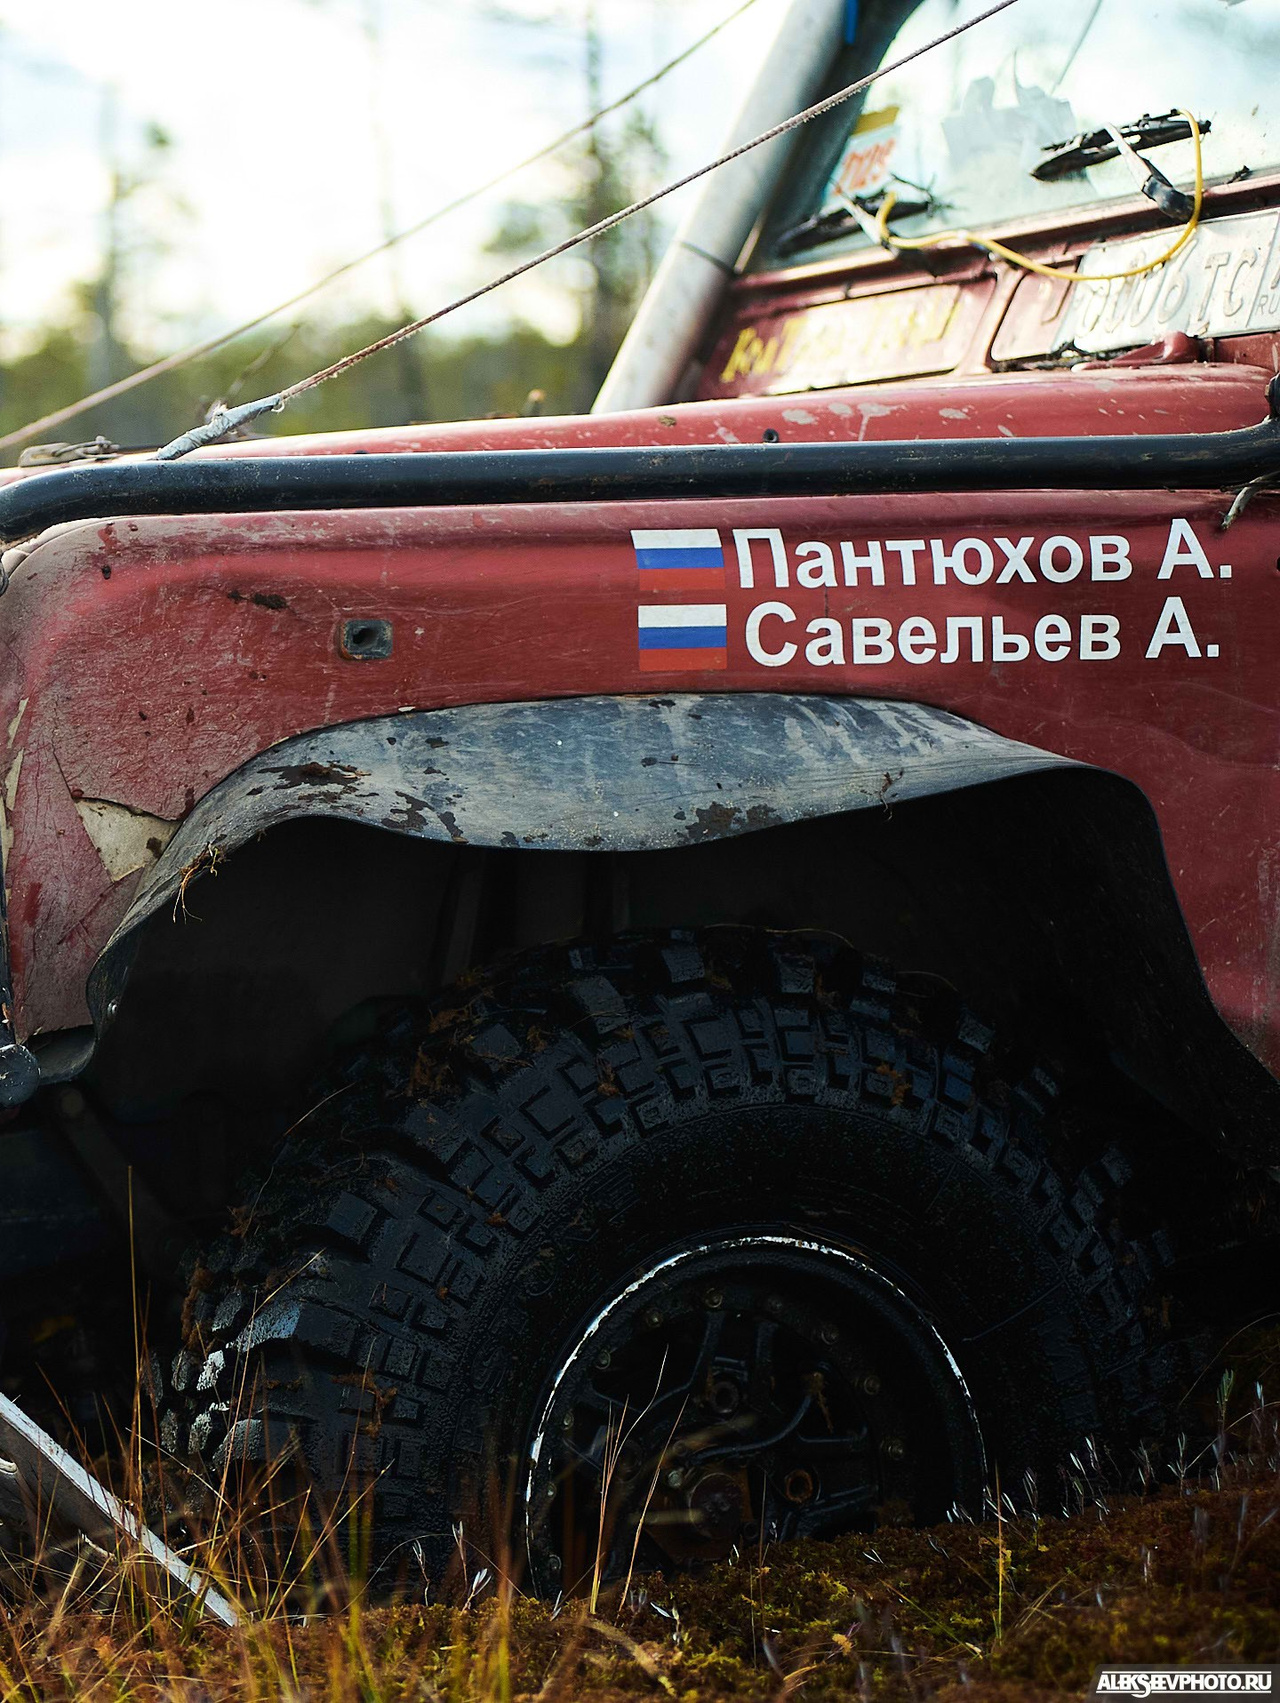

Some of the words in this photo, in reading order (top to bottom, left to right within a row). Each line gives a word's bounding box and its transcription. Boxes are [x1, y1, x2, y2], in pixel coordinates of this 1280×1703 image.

[732, 528, 1133, 589] Пантюхов
[1156, 518, 1233, 580] А.
[745, 601, 1121, 667] Савельев
[1145, 596, 1221, 659] А.
